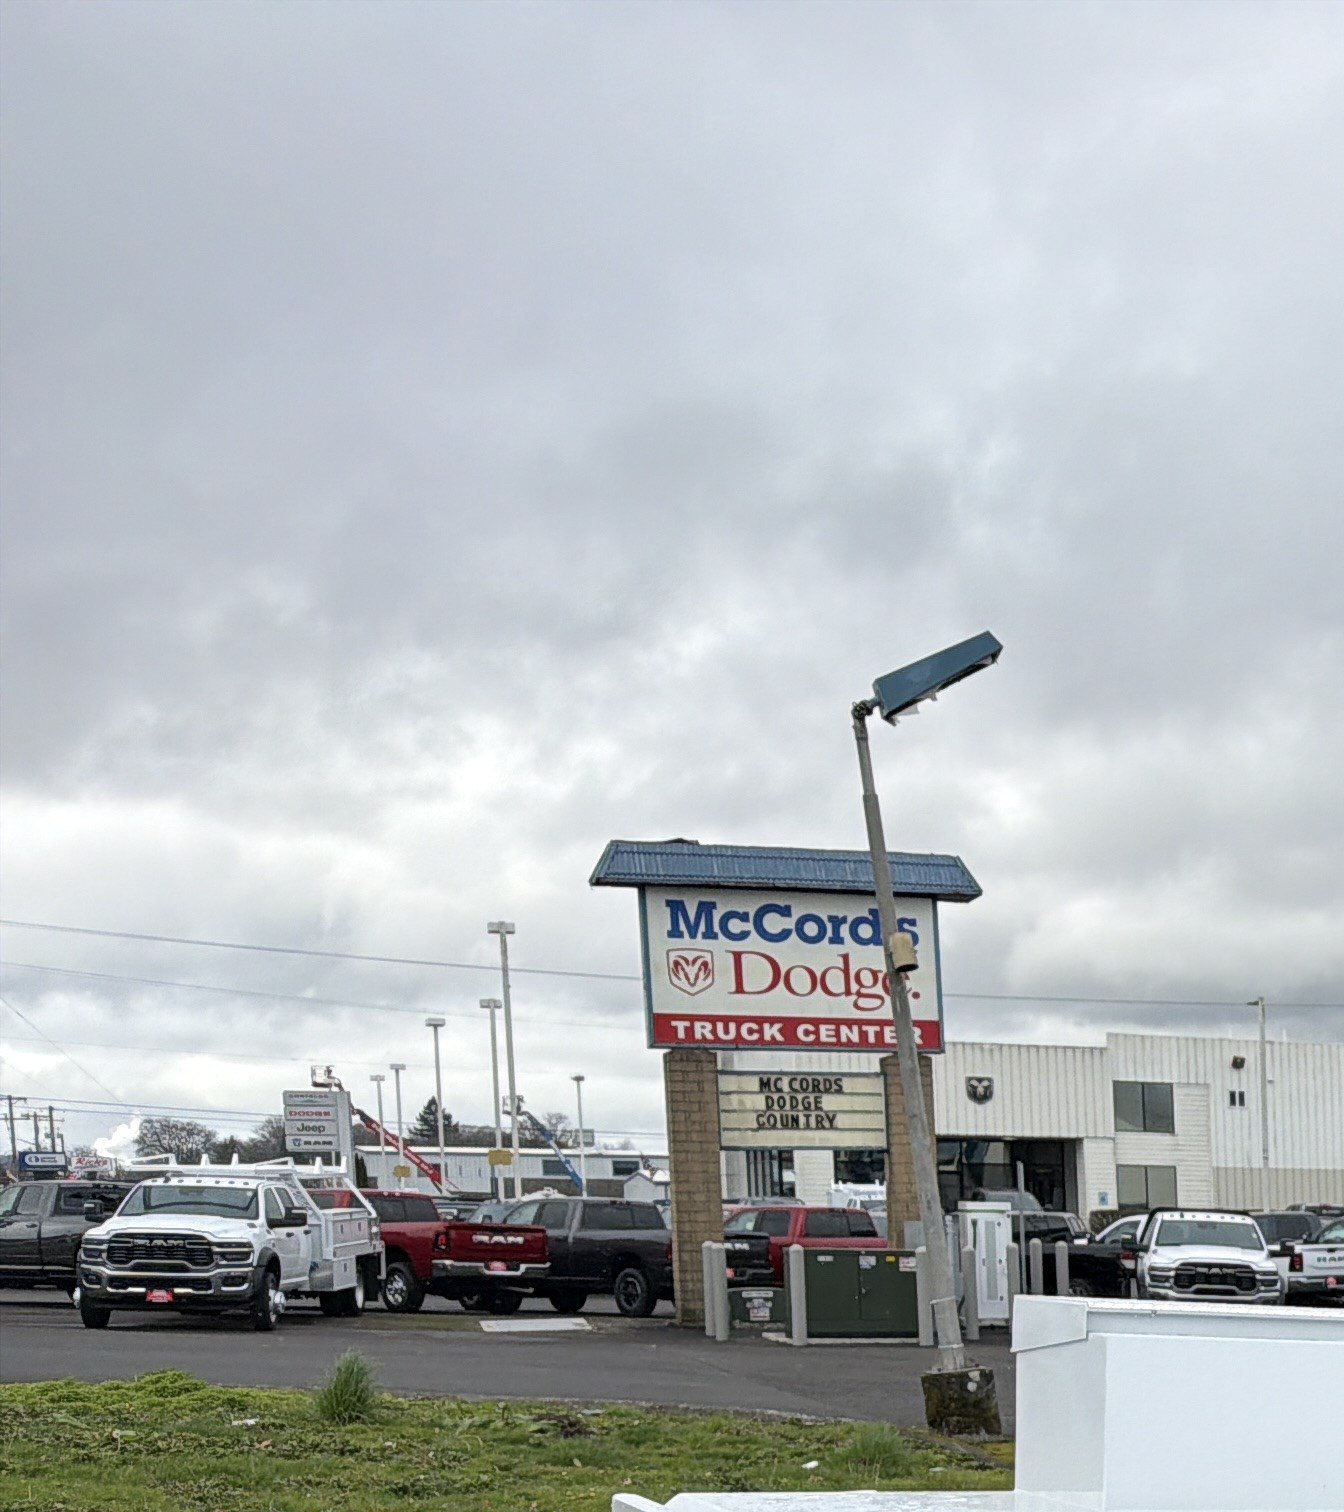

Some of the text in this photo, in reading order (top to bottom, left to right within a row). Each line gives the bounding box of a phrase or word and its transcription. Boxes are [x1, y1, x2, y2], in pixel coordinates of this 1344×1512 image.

[665, 899, 919, 947] McCords
[671, 1020, 784, 1042] TRUCK
[759, 1077, 844, 1092] MC CORDS
[765, 1095, 823, 1111] DODGE
[297, 1122, 325, 1134] Jeep
[756, 1113, 837, 1129] COUNTRY
